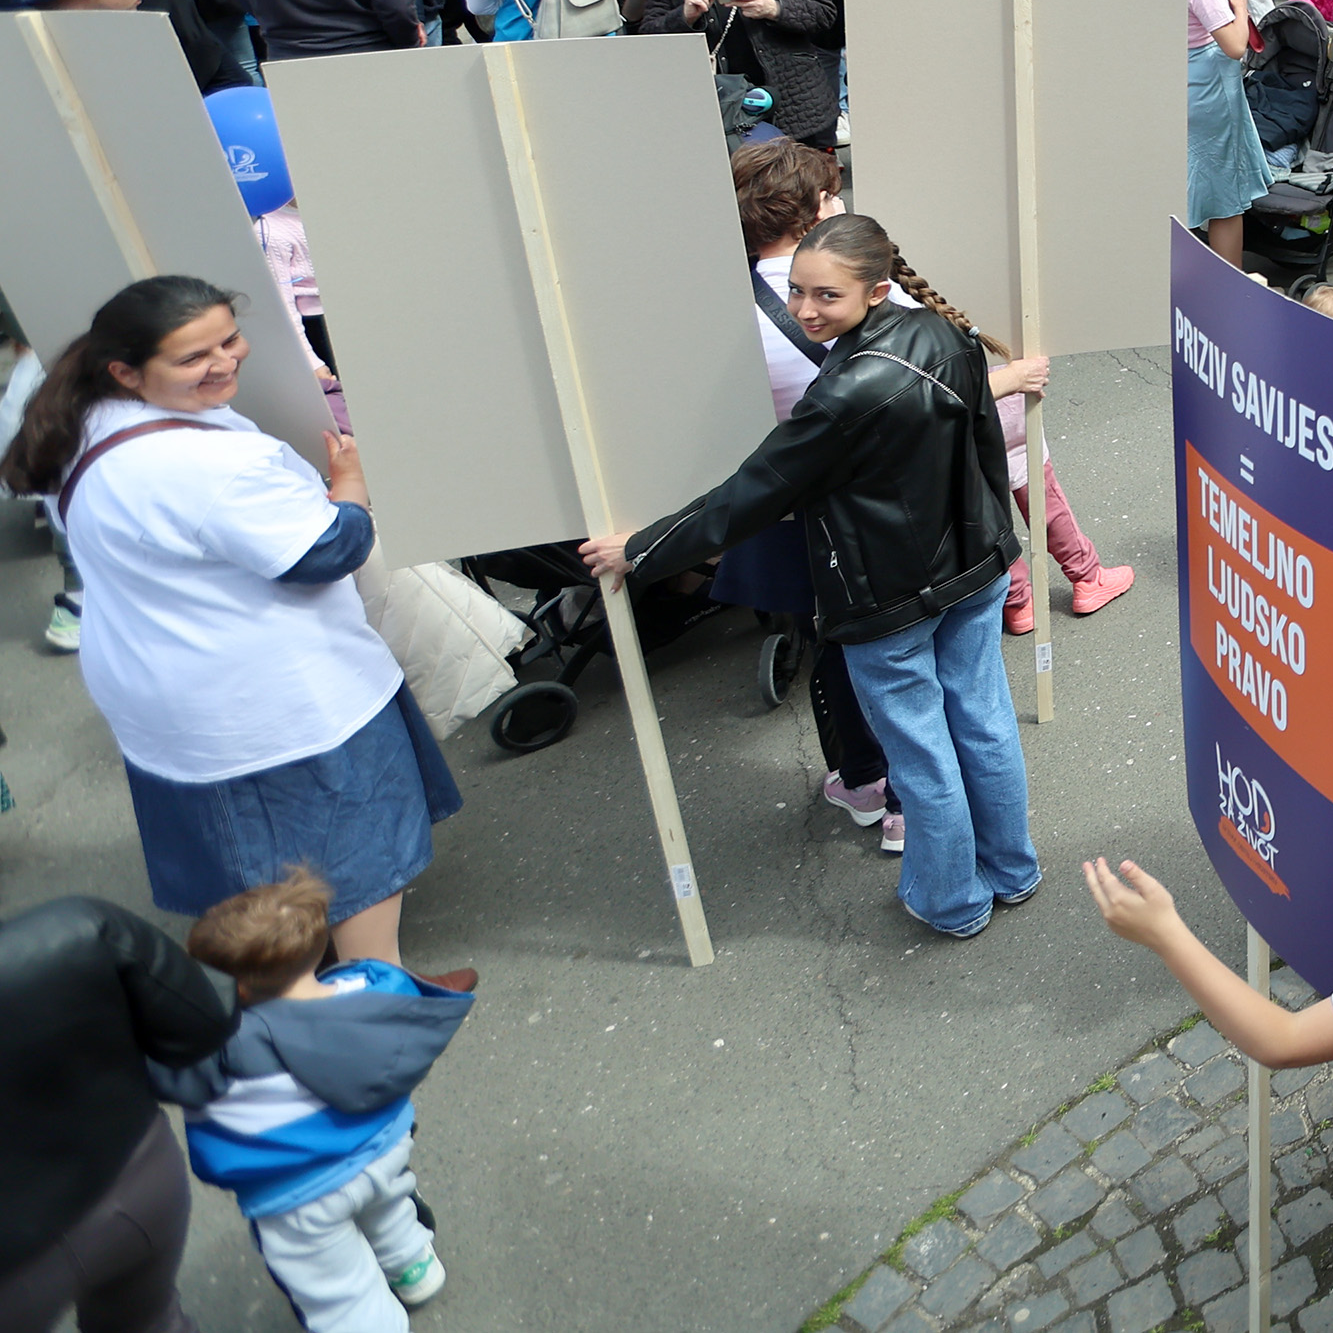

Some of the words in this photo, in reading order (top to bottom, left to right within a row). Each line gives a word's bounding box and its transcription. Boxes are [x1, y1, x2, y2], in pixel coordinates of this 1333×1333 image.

[1175, 306, 1227, 399] PRIZIV
[1197, 466, 1314, 609] TEMELJNO
[1207, 544, 1306, 676] LJUDSKO
[1215, 620, 1288, 732] PRAVO
[1215, 740, 1276, 842] HOD
[1219, 792, 1236, 825] ZA
[1236, 811, 1279, 871] ŽIVOT
